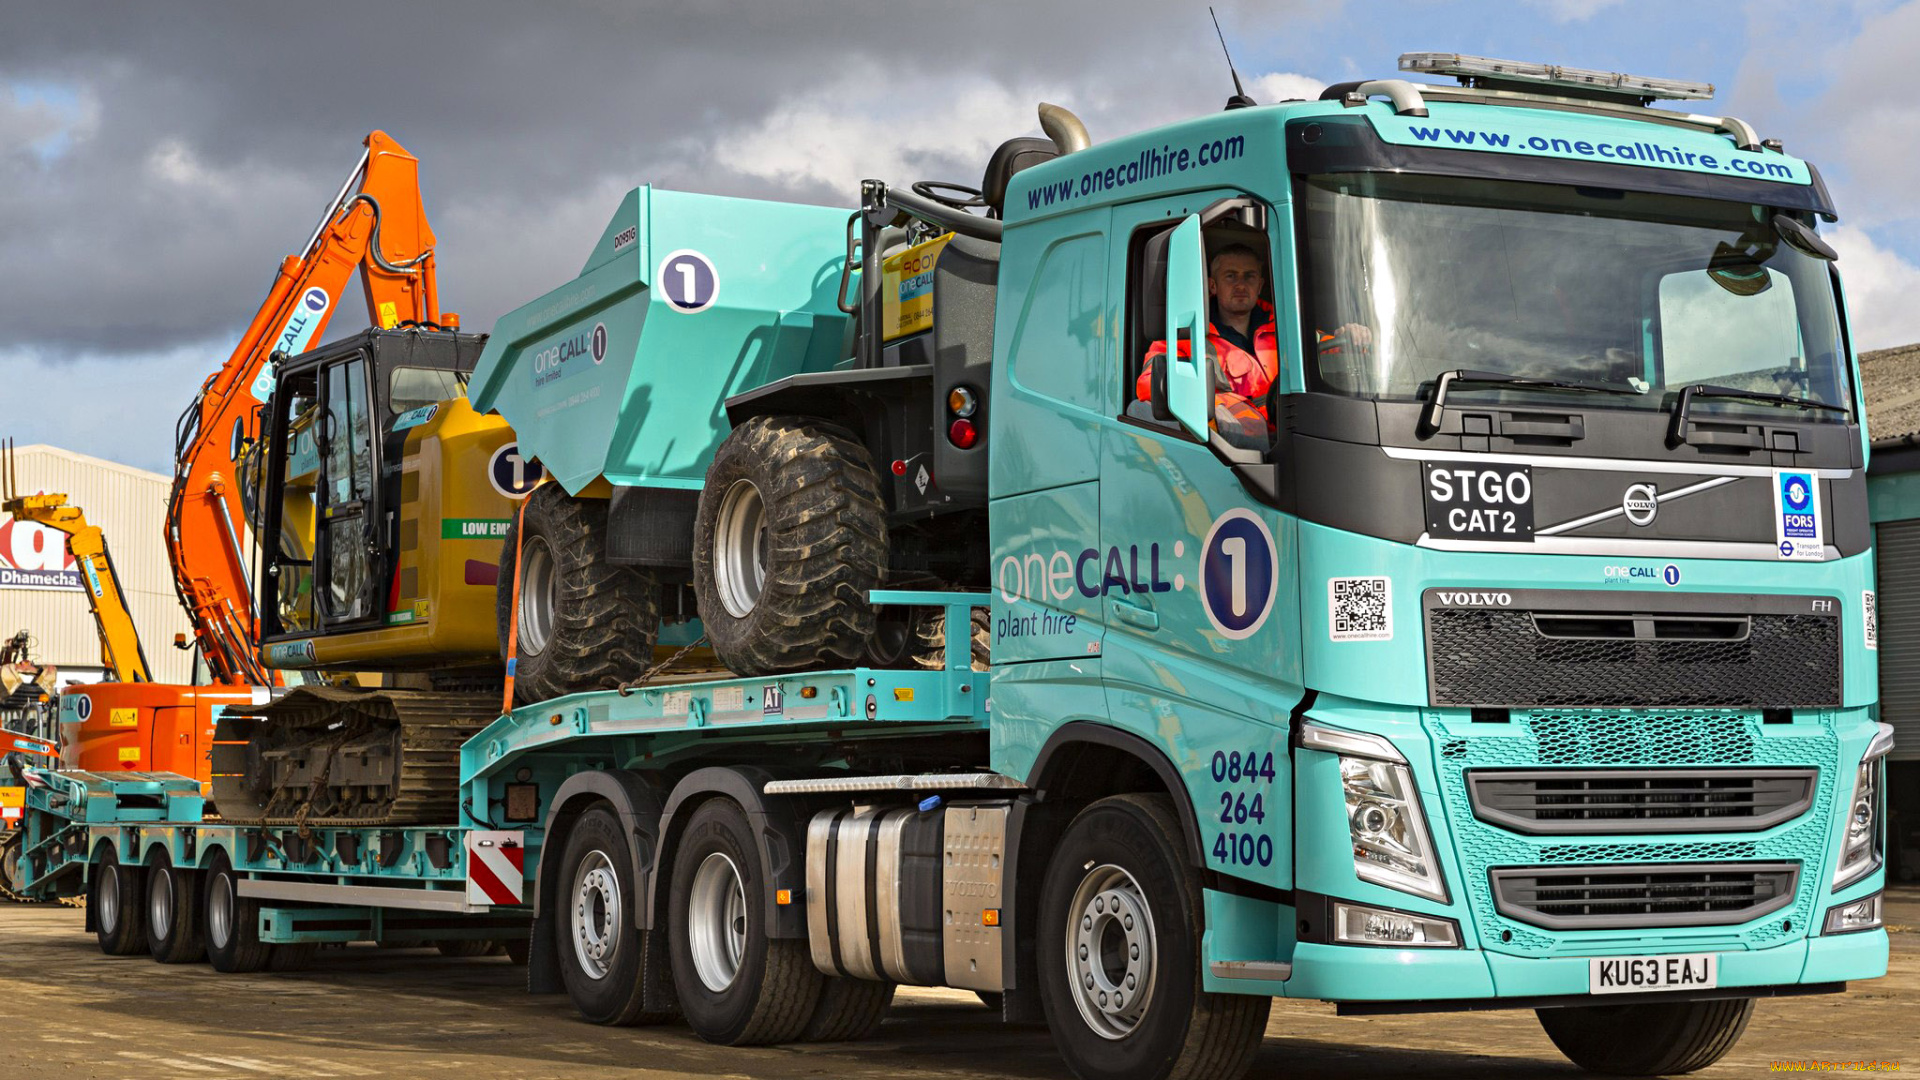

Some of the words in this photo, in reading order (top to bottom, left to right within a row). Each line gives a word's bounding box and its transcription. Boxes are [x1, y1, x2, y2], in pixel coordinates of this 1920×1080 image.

[1409, 126, 1793, 180] www.onecallhire.com
[1028, 135, 1245, 211] www.onecallhire.com
[675, 263, 696, 304] 1
[506, 454, 524, 489] 1
[1430, 469, 1531, 504] STGO
[462, 522, 488, 535] LOW
[1785, 514, 1813, 528] FORS
[1796, 542, 1820, 550] Transport
[2, 570, 76, 586] Dhamecha
[1604, 577, 1618, 585] plant
[1436, 592, 1512, 606] VOLVO
[1811, 600, 1832, 612] FH
[998, 610, 1036, 645] plant
[1042, 608, 1077, 636] hire
[764, 688, 780, 708] AT
[1211, 750, 1276, 784] 0844
[1220, 791, 1265, 825] 264
[1212, 832, 1273, 867] 4100
[946, 881, 998, 898] VOLVO
[1600, 959, 1659, 986] KU63
[1666, 958, 1708, 984] EAJ
